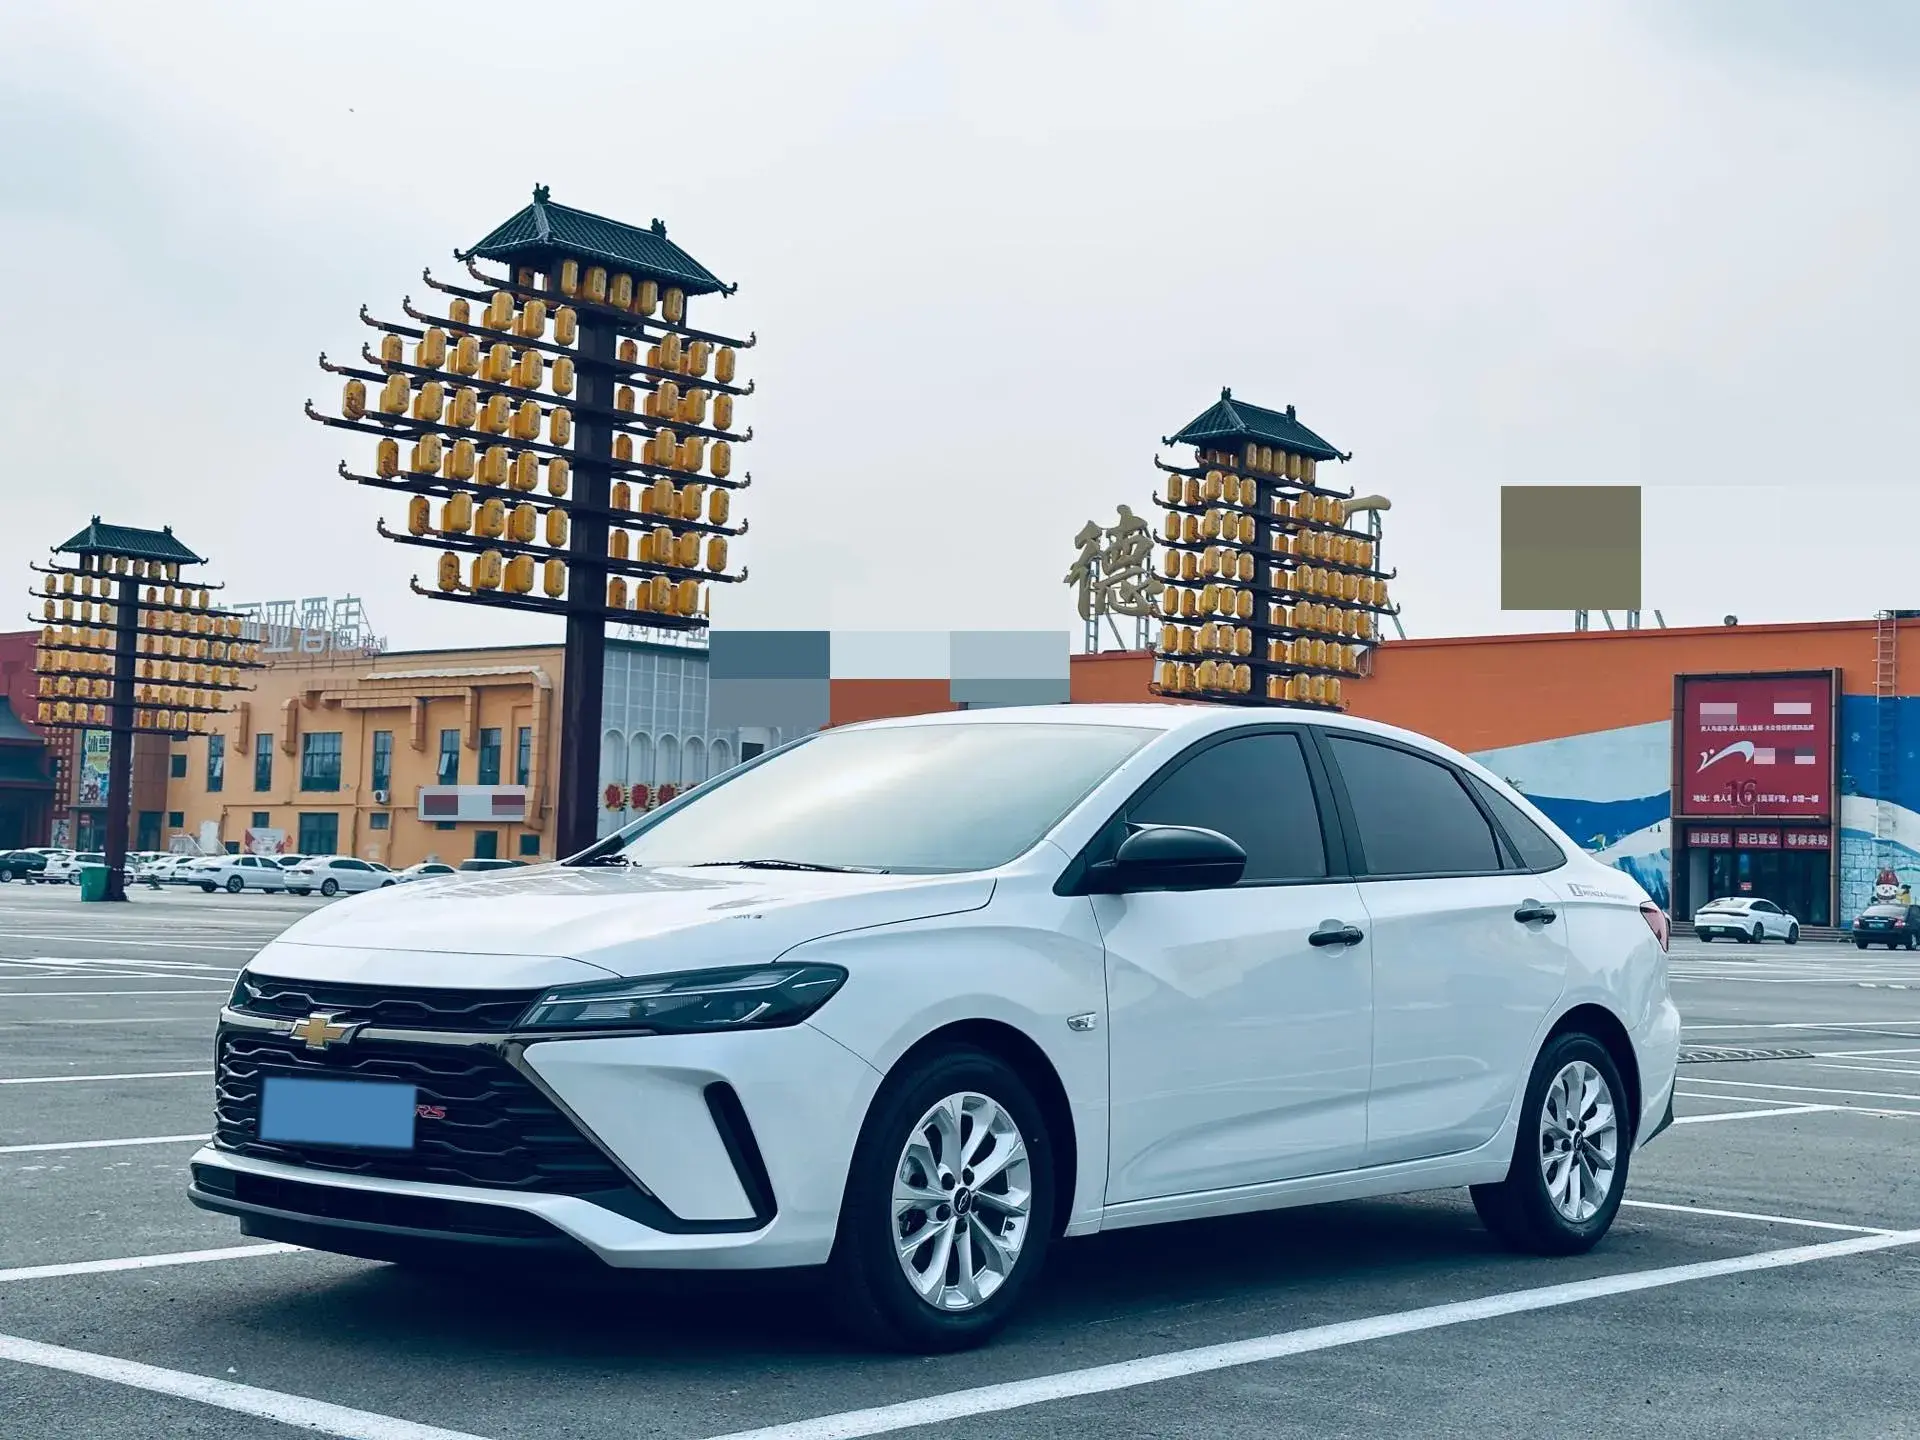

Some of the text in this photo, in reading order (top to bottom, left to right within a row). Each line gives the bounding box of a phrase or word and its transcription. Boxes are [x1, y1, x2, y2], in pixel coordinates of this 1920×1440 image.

[1690, 833, 1828, 846] 超级百货 现已营业 等你来购
[414, 1104, 447, 1120] RS
